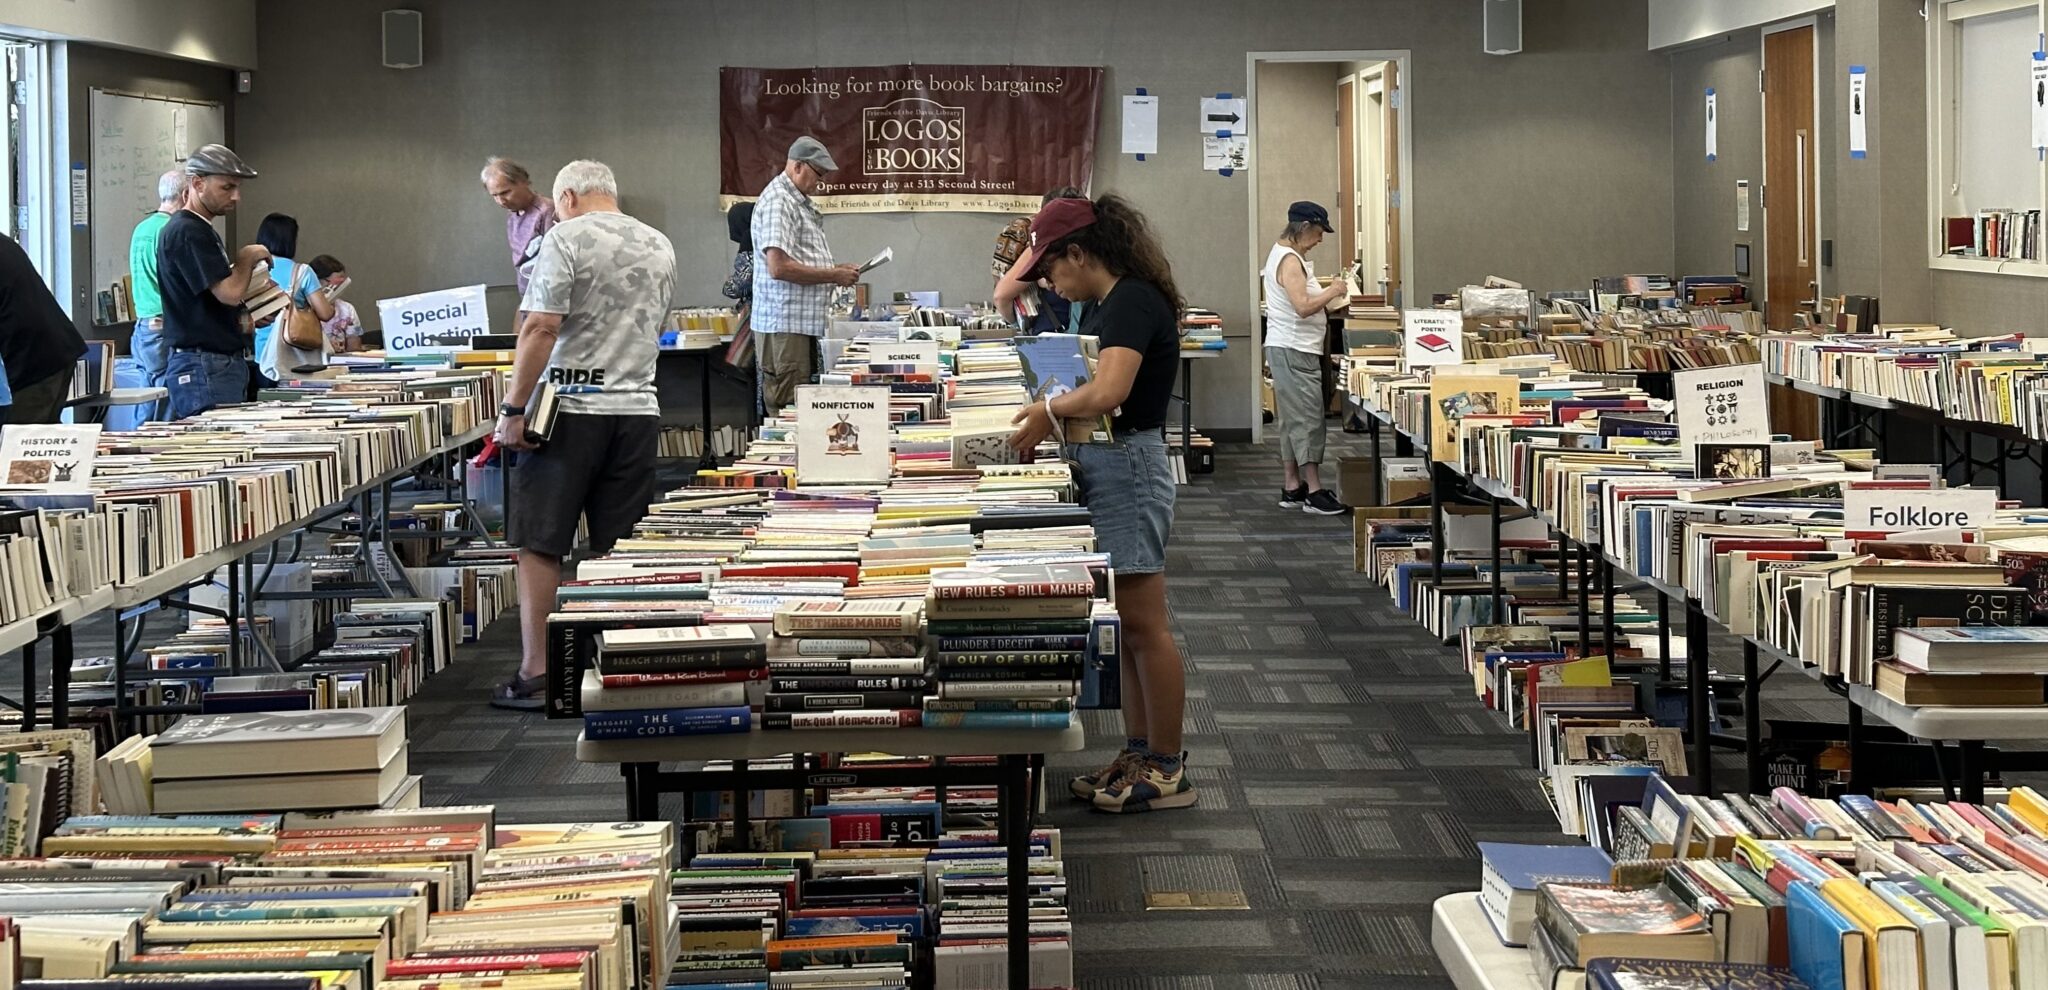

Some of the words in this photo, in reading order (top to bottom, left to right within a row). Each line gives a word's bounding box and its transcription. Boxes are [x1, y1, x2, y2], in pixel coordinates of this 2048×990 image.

[765, 77, 840, 99] Looking
[847, 77, 872, 93] for
[879, 78, 922, 91] more
[929, 74, 974, 91] book
[982, 75, 1063, 97] bargains?
[936, 109, 960, 117] Library
[867, 118, 961, 143] LOGOS
[875, 147, 961, 171] BOOKS
[816, 181, 845, 192] Open
[849, 181, 877, 192] every
[883, 180, 900, 191] day
[904, 179, 914, 189] at
[917, 179, 934, 189] 513
[938, 179, 976, 189] Second
[980, 180, 1015, 190] Street!
[841, 200, 870, 208] Friends
[898, 199, 918, 207] Davis
[921, 199, 949, 209] Library
[401, 302, 468, 327] Special
[888, 353, 921, 362] SCIENCE
[550, 368, 605, 385] RIDE
[1696, 379, 1744, 391] RELIGION
[811, 401, 875, 410] NONFICTION
[1870, 506, 1968, 526] Folklore
[934, 587, 963, 599] NEW
[965, 586, 1005, 598] RULES
[1018, 584, 1045, 596] BILL
[1051, 583, 1094, 595] MAHER
[790, 618, 813, 627] THE
[815, 618, 855, 628] THREE
[855, 617, 901, 628] MARIAS
[1877, 593, 1887, 641] HERSHEL
[564, 628, 574, 664] DIANE
[943, 638, 989, 650] PLUNDER
[998, 638, 1034, 649] DECEIT
[613, 657, 650, 666] BREACH
[666, 656, 694, 664] FAITH
[957, 655, 987, 664] OUT
[996, 655, 1015, 664] OF
[1023, 654, 1069, 664] SIGHT
[950, 671, 992, 679] AMERICAN
[564, 667, 574, 714] RAVITCH
[779, 680, 798, 689] THE
[857, 680, 887, 688] RULES
[643, 714, 669, 723] THE
[839, 715, 898, 727] democracy
[637, 725, 675, 735] CODE
[1768, 763, 1795, 775] MAKE
[1797, 763, 1807, 775] IT
[1768, 774, 1807, 789] COUNT
[405, 957, 450, 967] SPIKE
[457, 954, 540, 965] MILLIGAN
